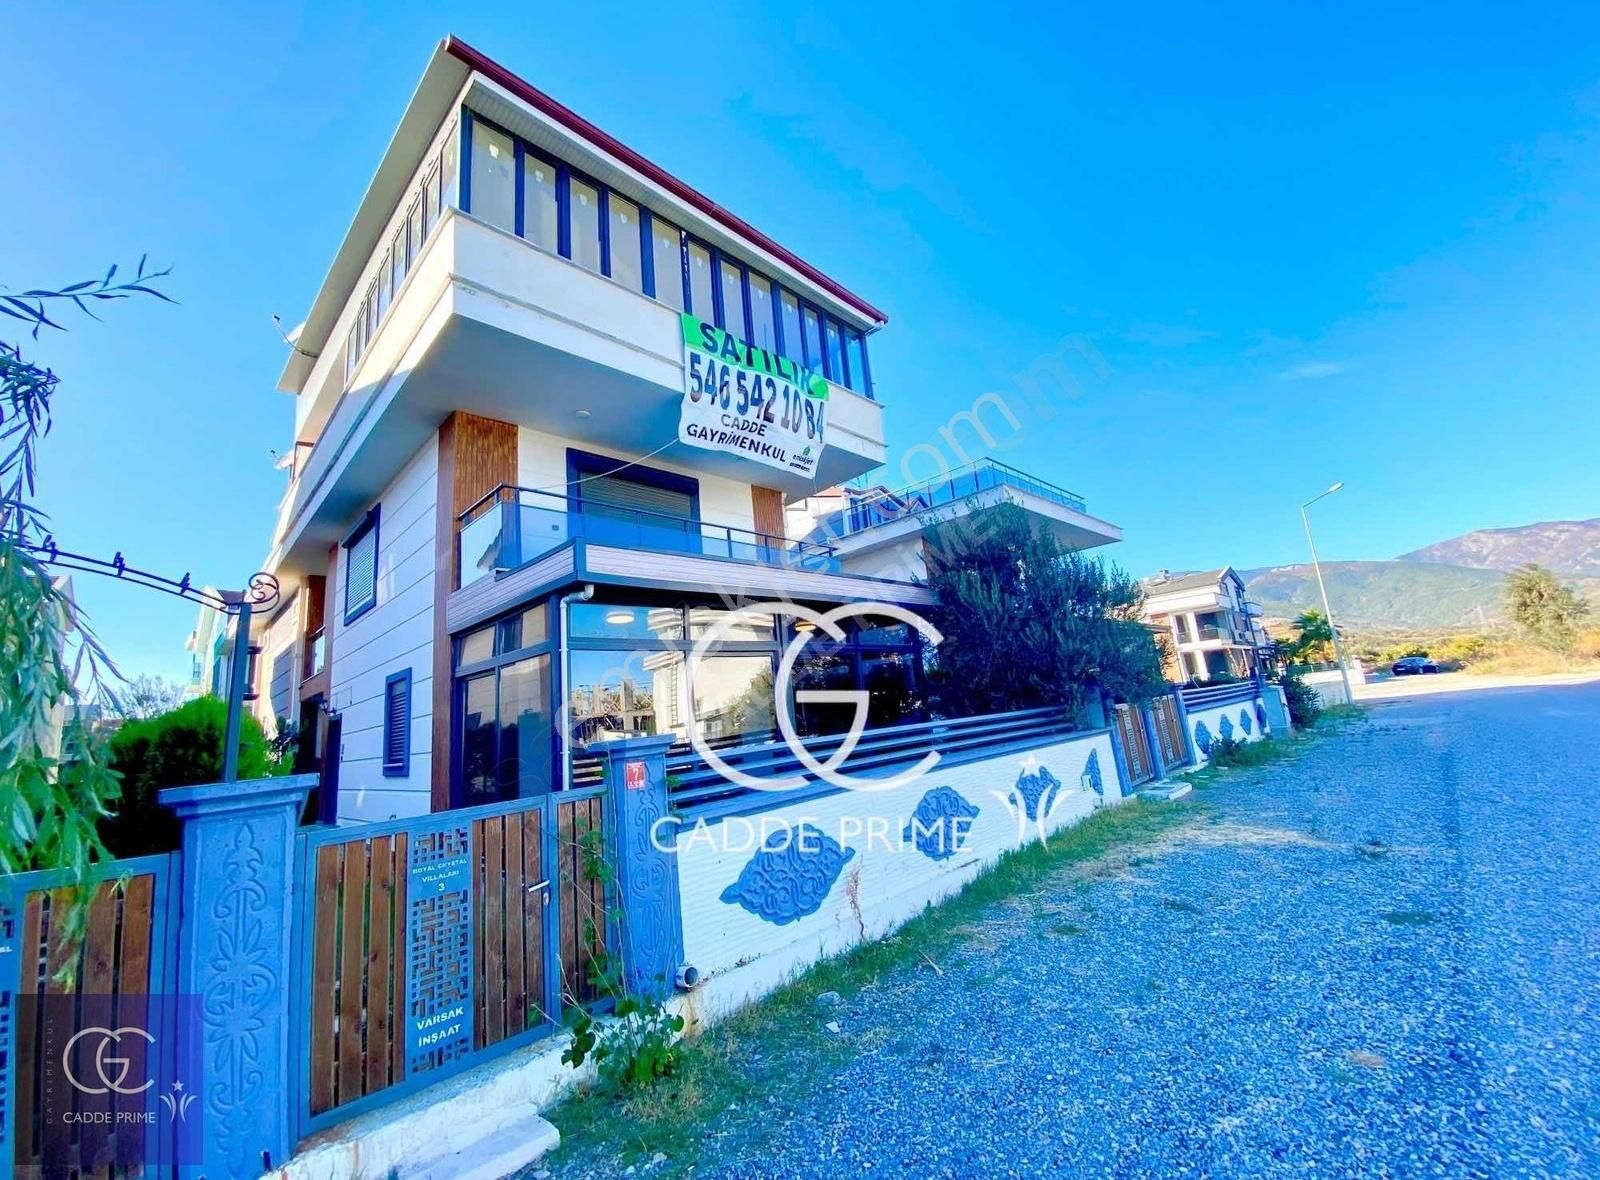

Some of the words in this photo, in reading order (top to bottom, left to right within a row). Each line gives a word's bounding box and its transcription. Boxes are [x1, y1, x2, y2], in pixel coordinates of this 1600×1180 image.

[699, 322, 815, 396] SATILIK
[689, 352, 731, 411] 546
[735, 370, 777, 425] 542
[780, 383, 803, 434] 10
[804, 400, 826, 444] 84
[720, 413, 768, 438] CADDE
[438, 882, 446, 892] 3
[416, 1006, 464, 1031] VARSAK
